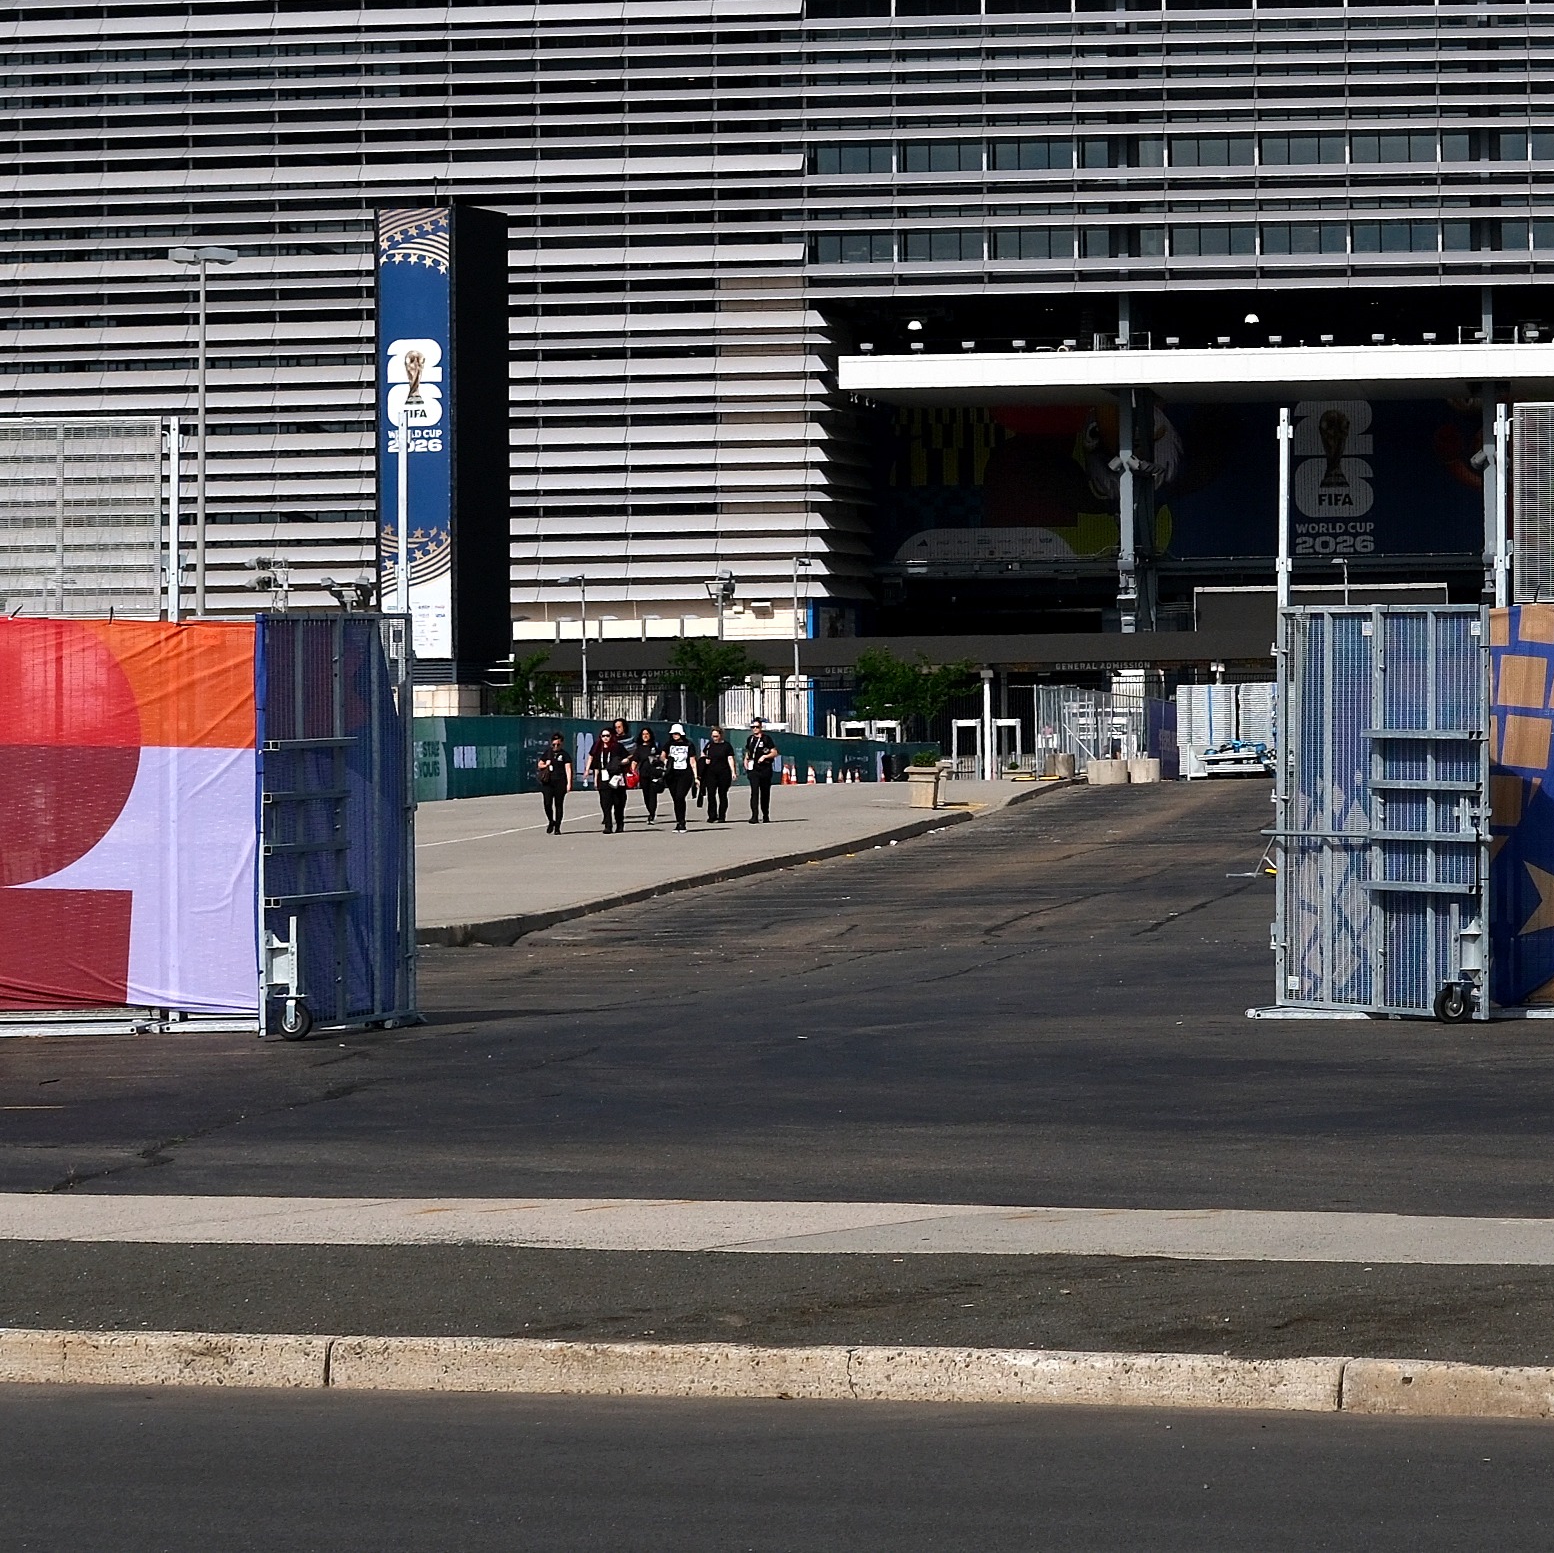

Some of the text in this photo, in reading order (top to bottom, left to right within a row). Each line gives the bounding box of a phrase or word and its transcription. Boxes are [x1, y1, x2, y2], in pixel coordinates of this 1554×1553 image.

[387, 429, 442, 438] WLD CUP
[1318, 494, 1353, 506] FIFA
[1295, 522, 1375, 534] WORLD CUP
[1295, 535, 1375, 554] 2026
[824, 666, 853, 675] GENE
[1055, 661, 1151, 671] GENERAL ADMISSION
[598, 669, 685, 679] GENERAL ADMISSIO
